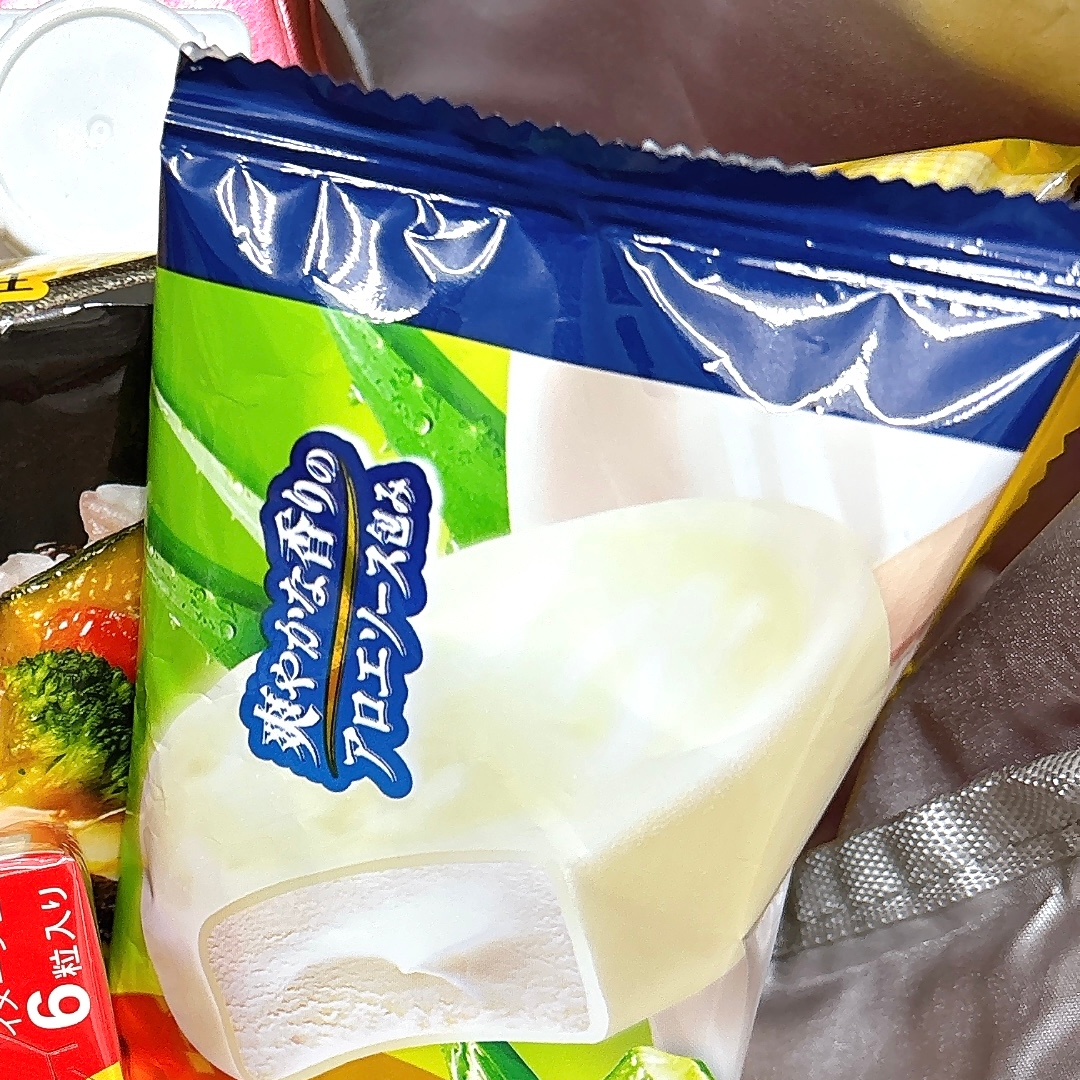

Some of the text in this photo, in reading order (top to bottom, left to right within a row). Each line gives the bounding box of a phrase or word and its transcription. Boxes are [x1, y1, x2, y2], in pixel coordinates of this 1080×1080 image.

[253, 447, 340, 768] 爽やかな香りの
[343, 477, 417, 784] アロエソース包み
[26, 887, 92, 1030] 6粒入り
